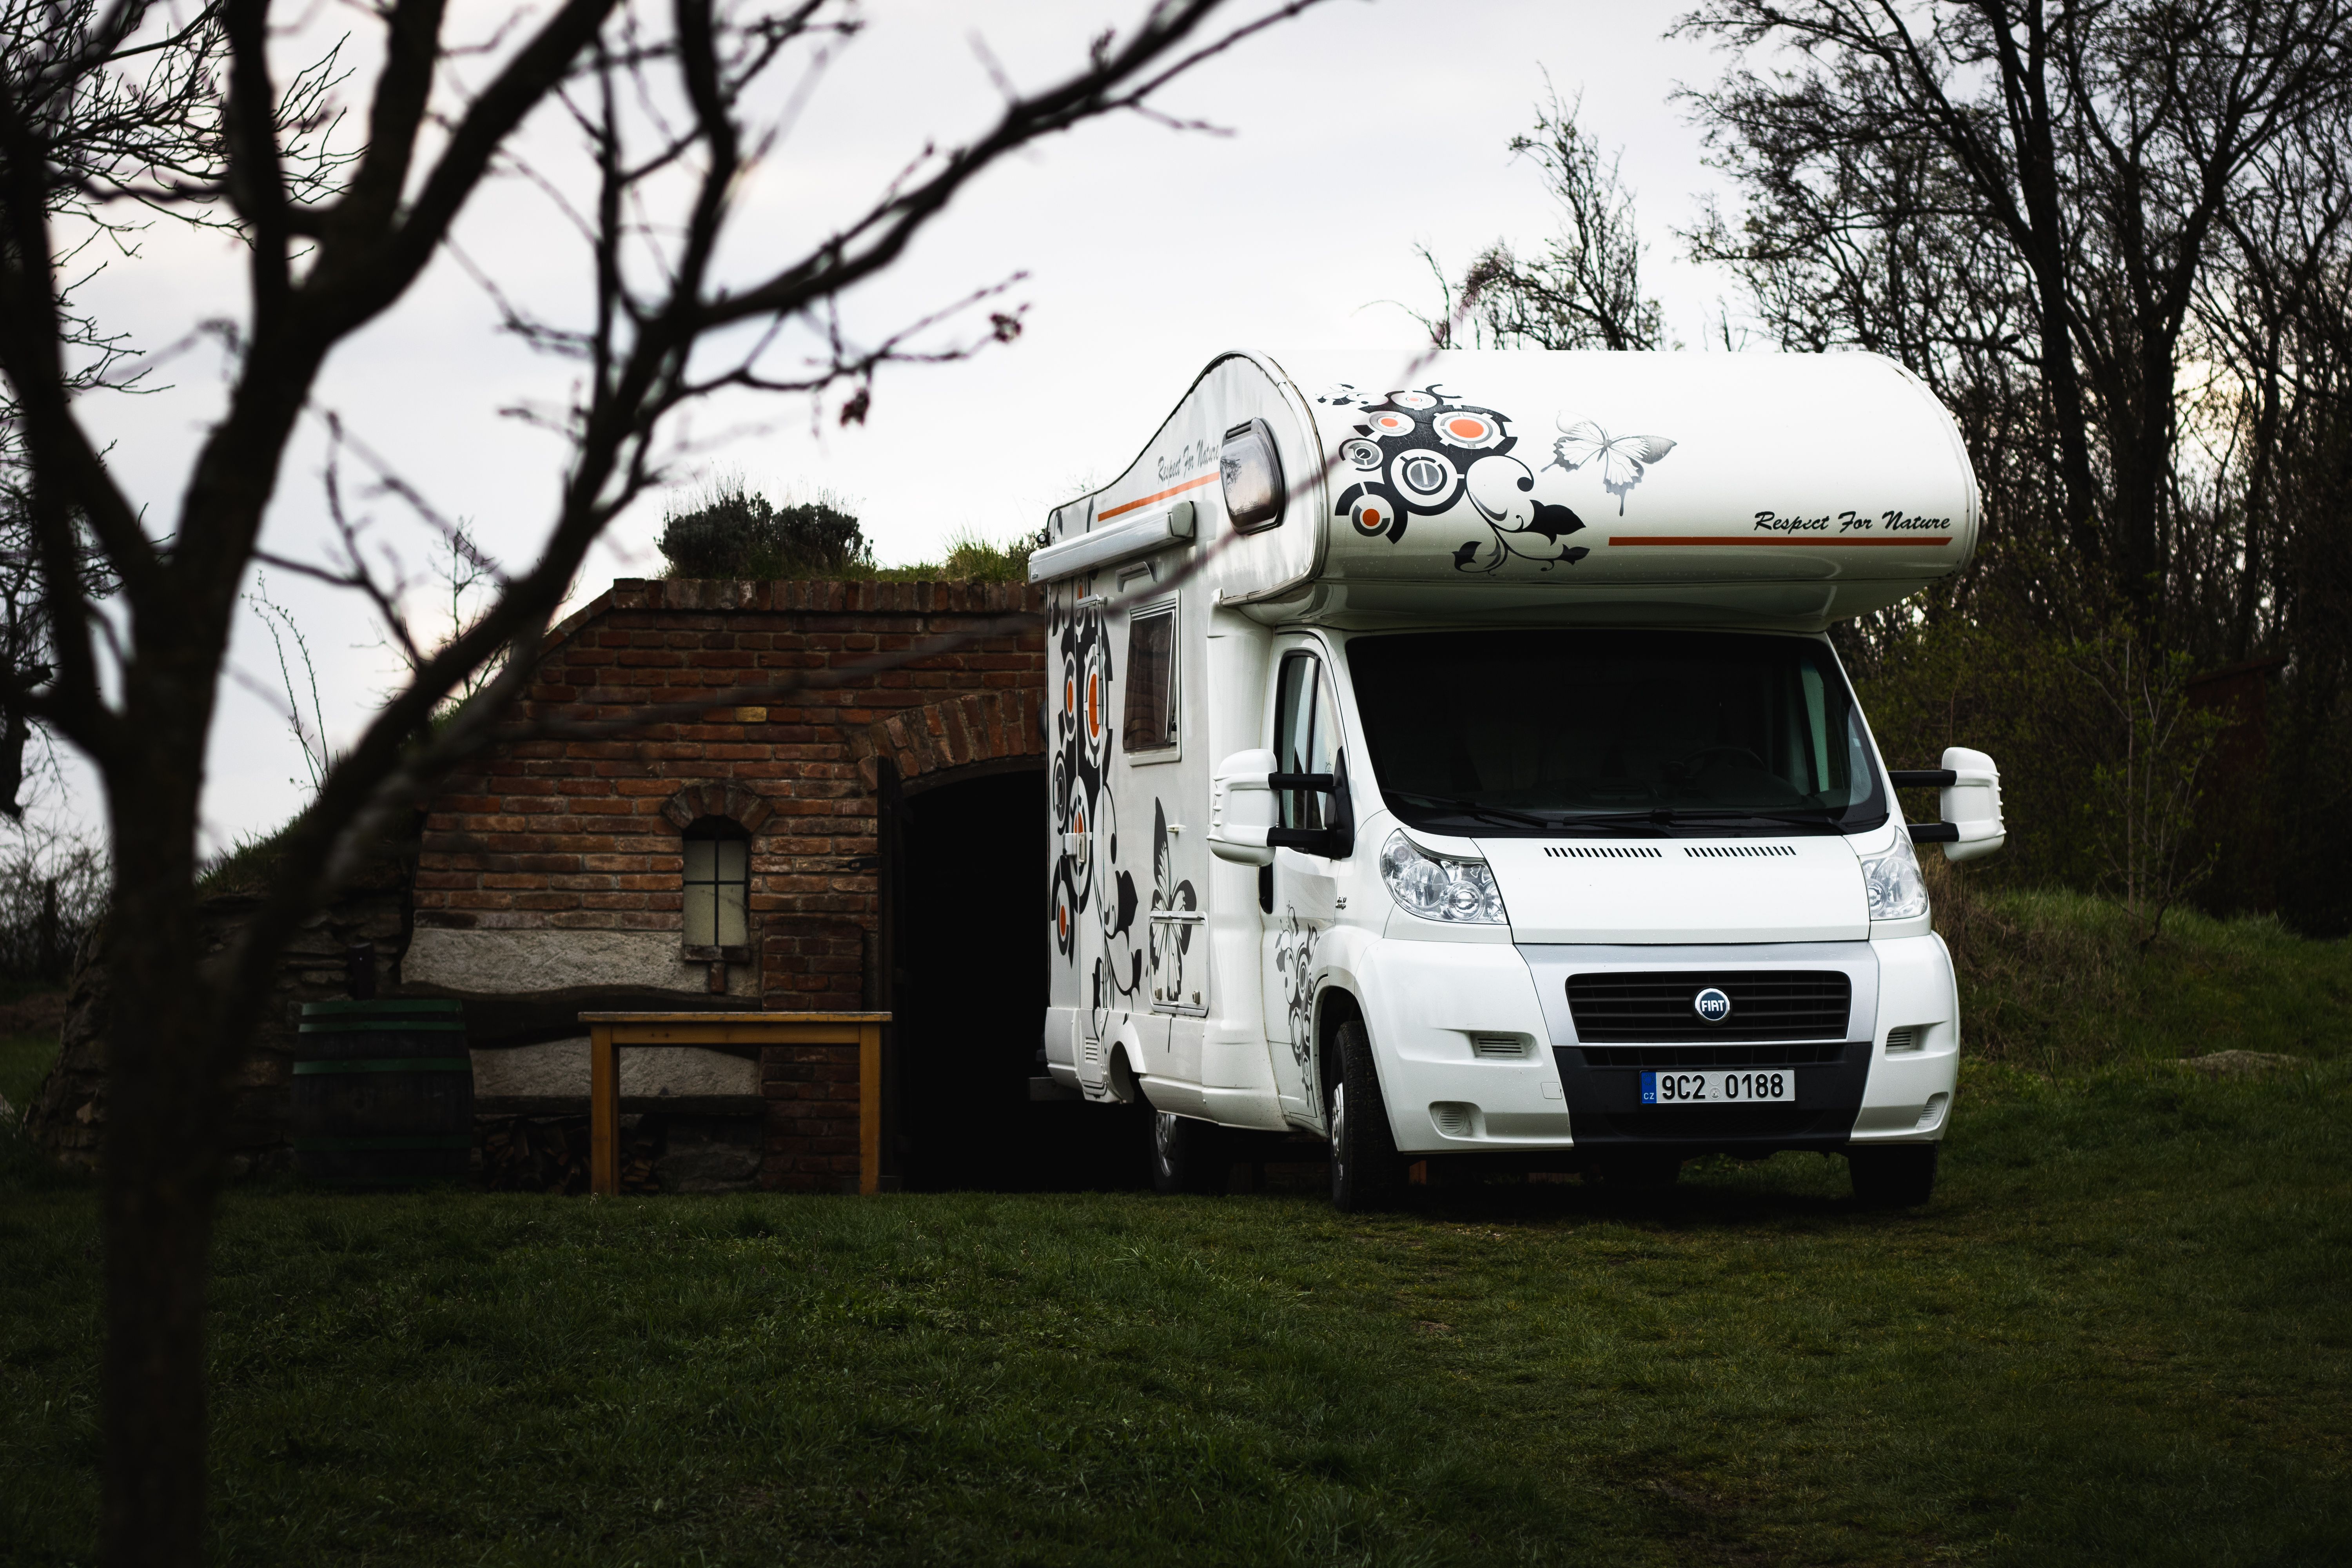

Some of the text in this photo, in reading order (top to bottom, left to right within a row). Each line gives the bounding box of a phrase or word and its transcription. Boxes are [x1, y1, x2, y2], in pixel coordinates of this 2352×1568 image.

[1158, 439, 1219, 486] Respect For Nature
[1753, 510, 1951, 535] Respect For Nature
[1701, 1000, 1725, 1012] FIAT
[1662, 1073, 1784, 1100] 9C2 0188
